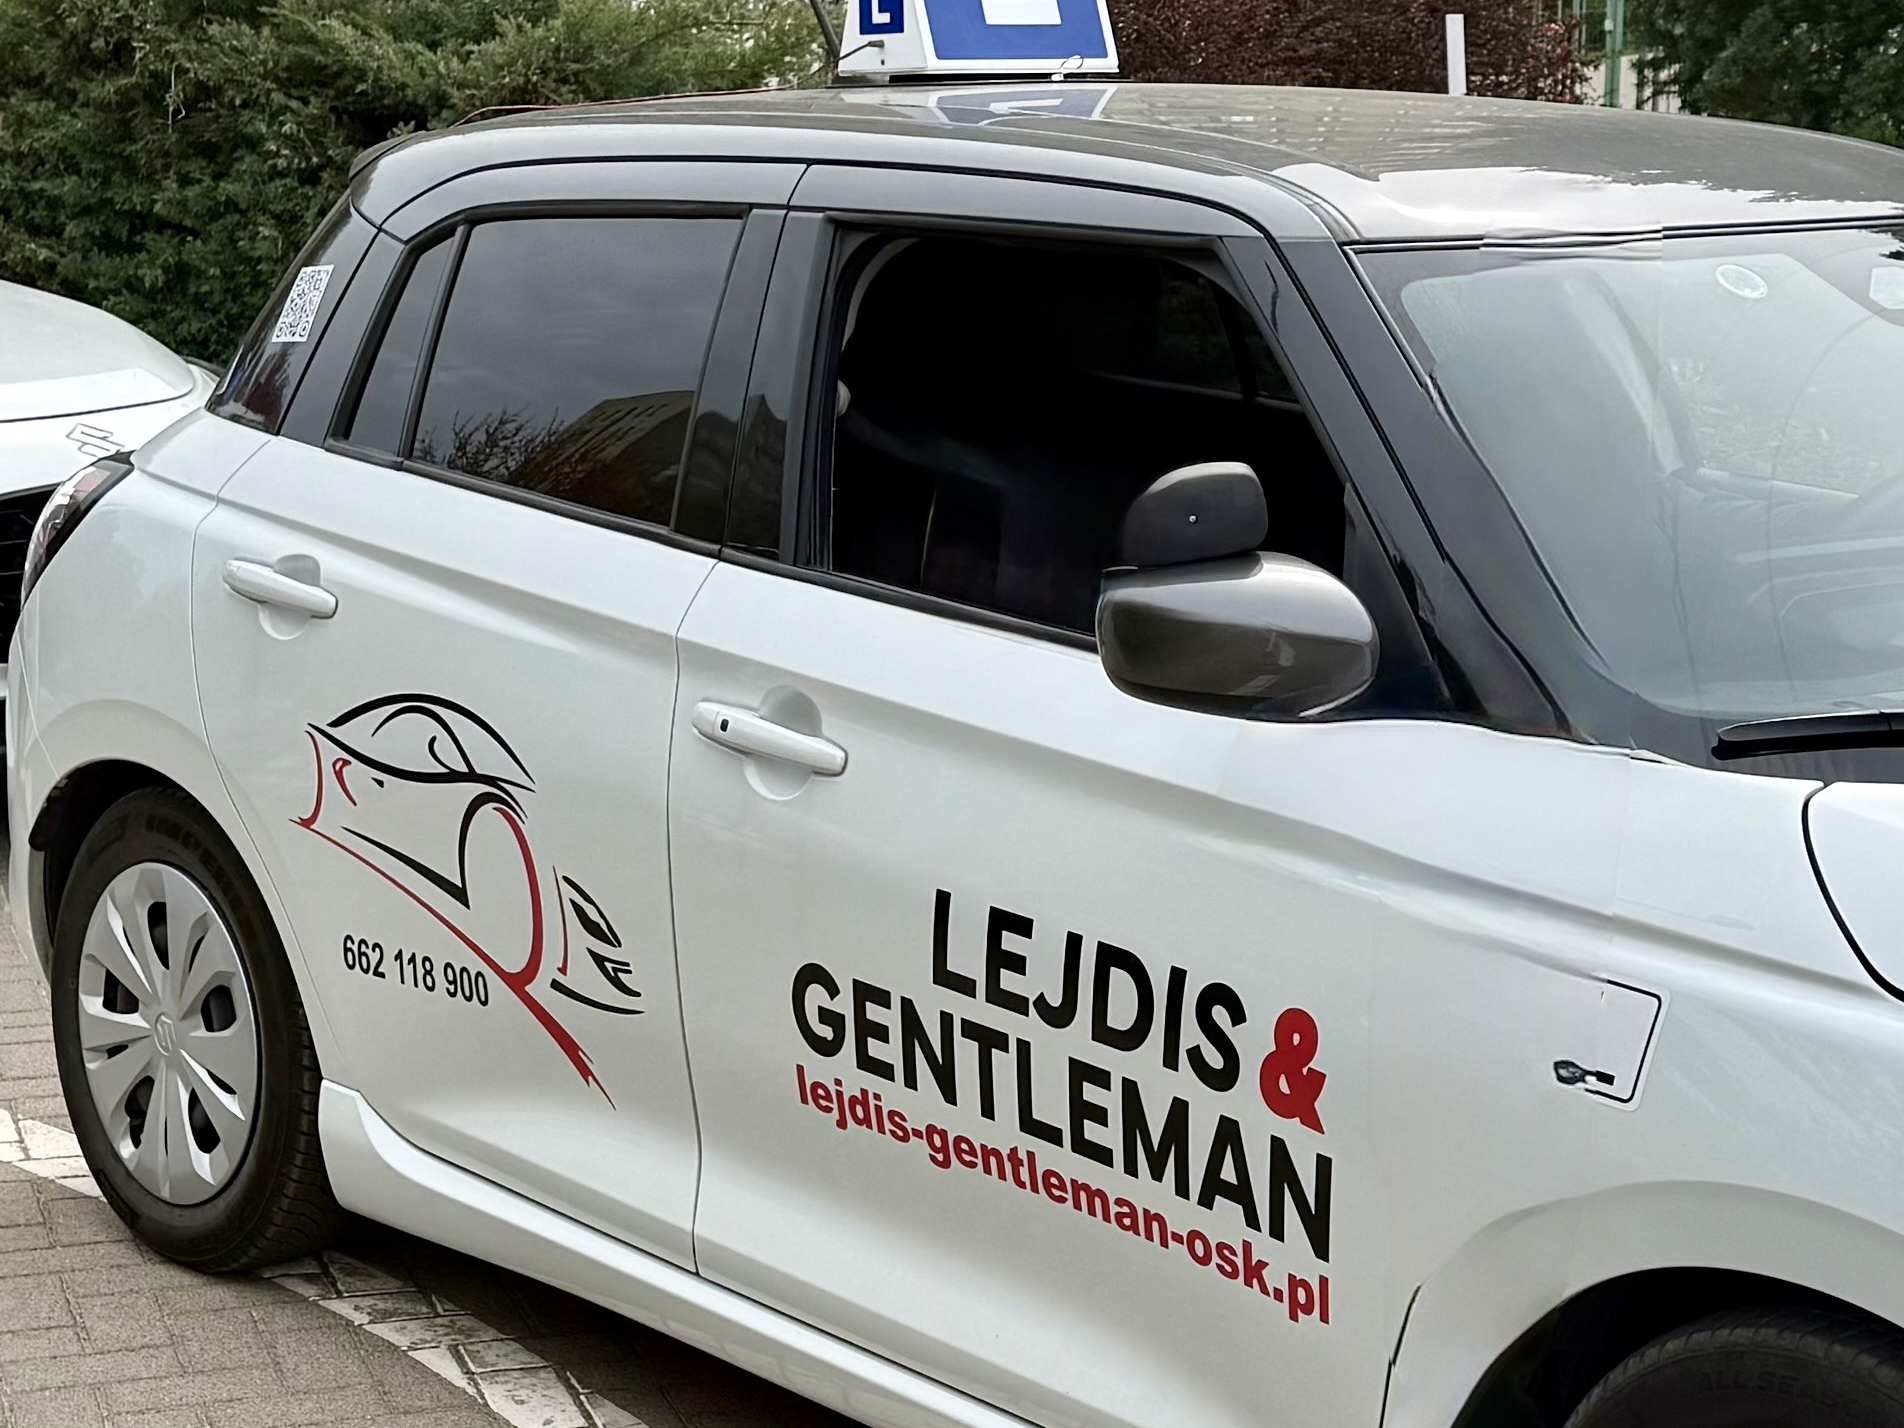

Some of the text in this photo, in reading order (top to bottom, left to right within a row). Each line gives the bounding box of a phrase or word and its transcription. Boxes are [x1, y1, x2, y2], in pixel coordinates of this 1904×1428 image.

[342, 934, 489, 1007] 662 118 900
[932, 888, 1248, 1093] LEJDIS
[791, 962, 1333, 1264] GENTLEMAN
[796, 1063, 1331, 1325] lejdis-gentleman-osk.pl
